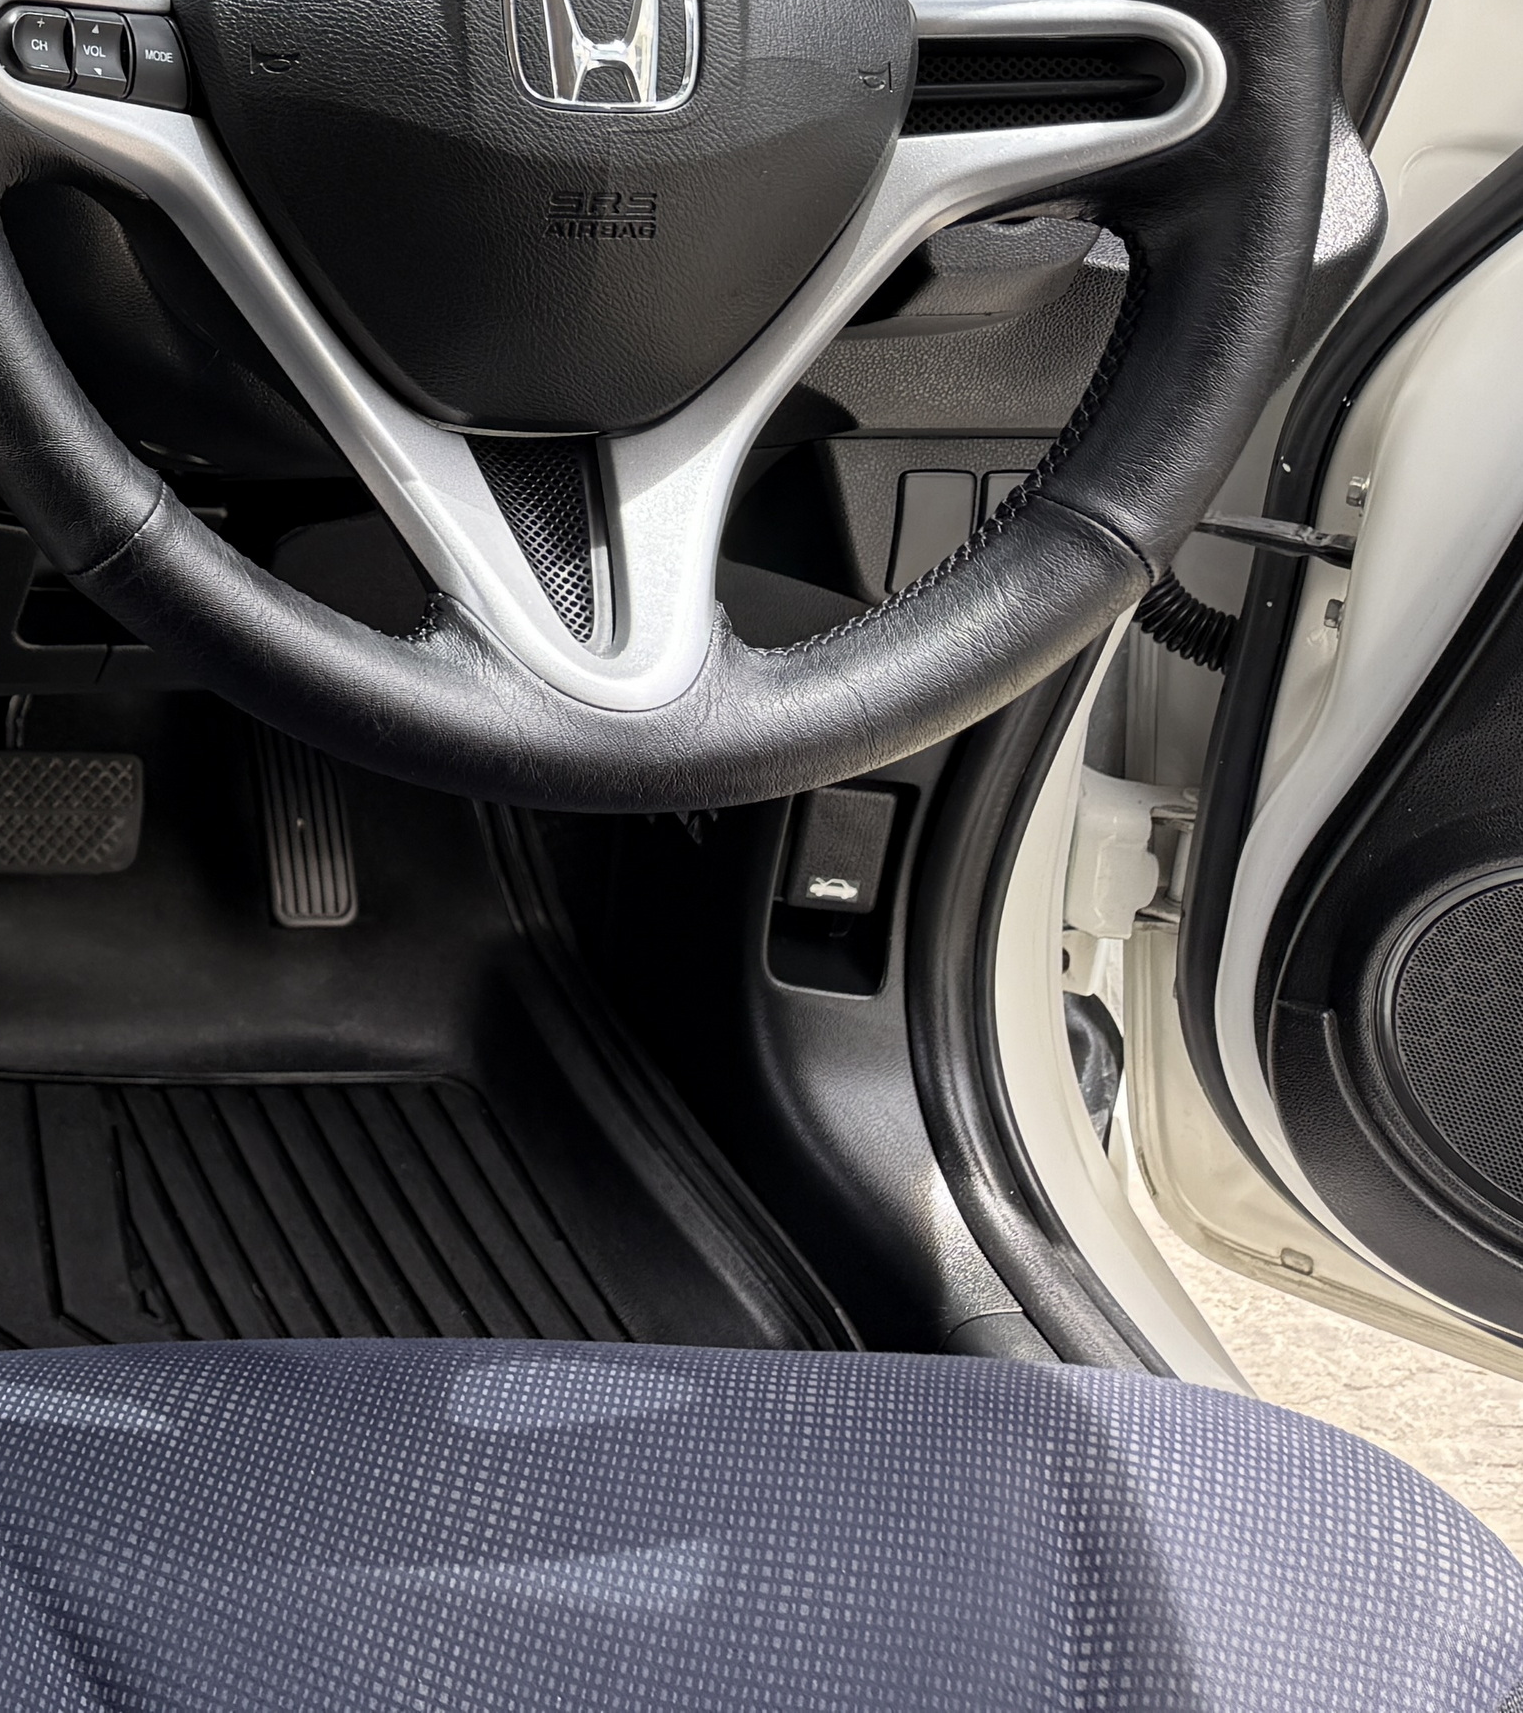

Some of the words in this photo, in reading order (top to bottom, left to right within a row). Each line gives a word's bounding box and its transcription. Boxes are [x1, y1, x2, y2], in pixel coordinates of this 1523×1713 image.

[31, 39, 49, 52] CH
[83, 44, 107, 58] VOL
[144, 49, 174, 64] MODE
[548, 191, 658, 214] SRS
[543, 221, 657, 240] AIRBAG
